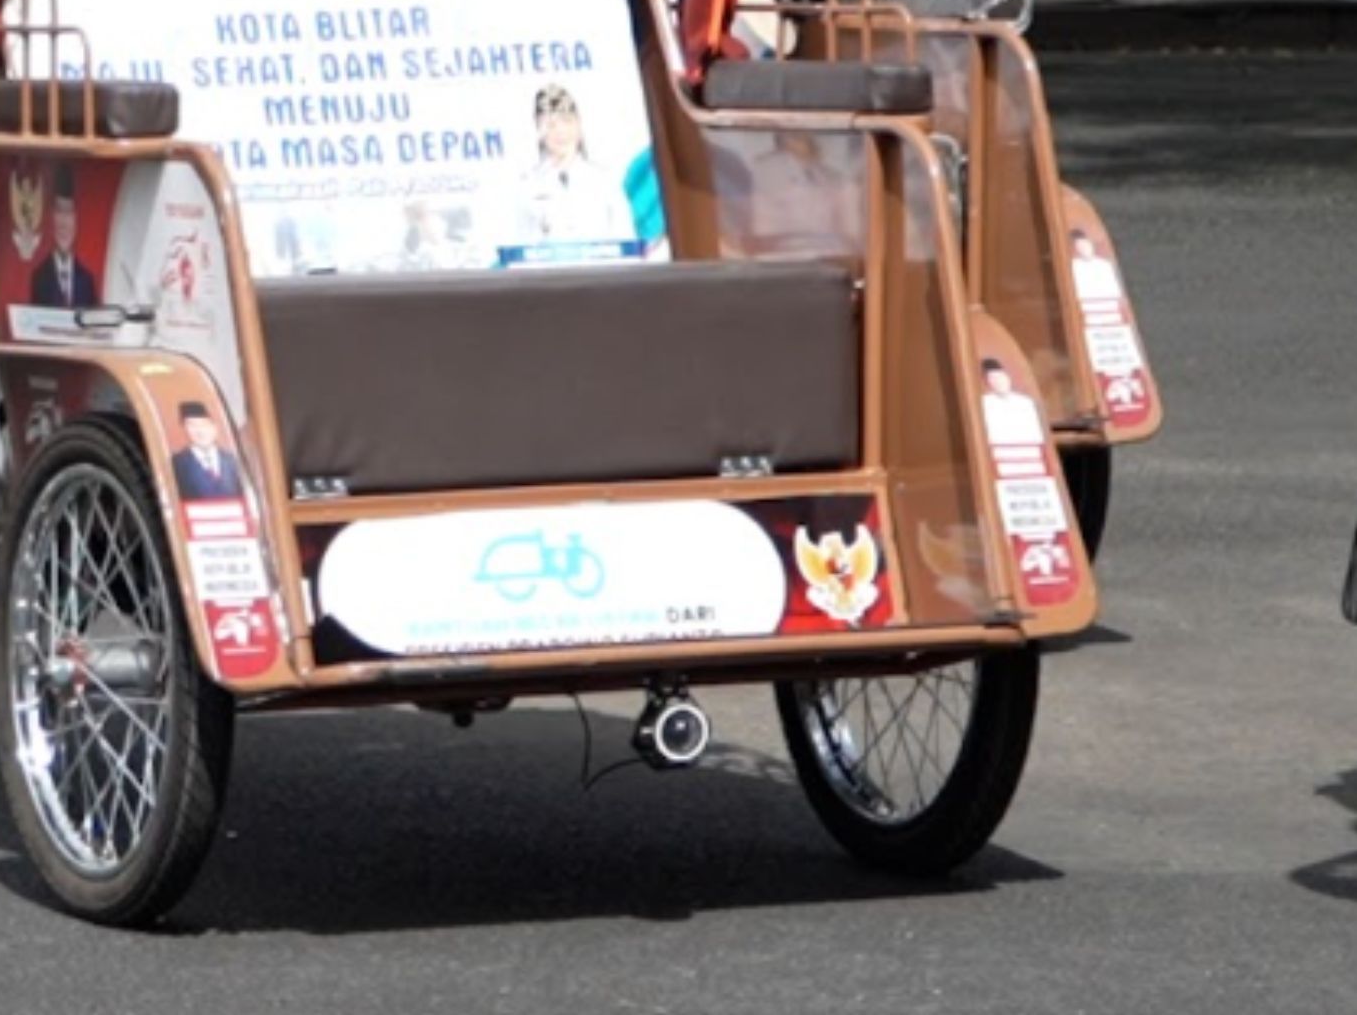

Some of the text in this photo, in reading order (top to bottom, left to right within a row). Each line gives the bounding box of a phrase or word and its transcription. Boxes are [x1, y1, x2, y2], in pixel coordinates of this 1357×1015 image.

[215, 5, 431, 45] KOTA BLITAR
[401, 39, 593, 80] SEJAHTERA
[262, 91, 412, 127] MENUJU
[279, 134, 385, 169] MASA
[396, 129, 506, 165] DEPAN
